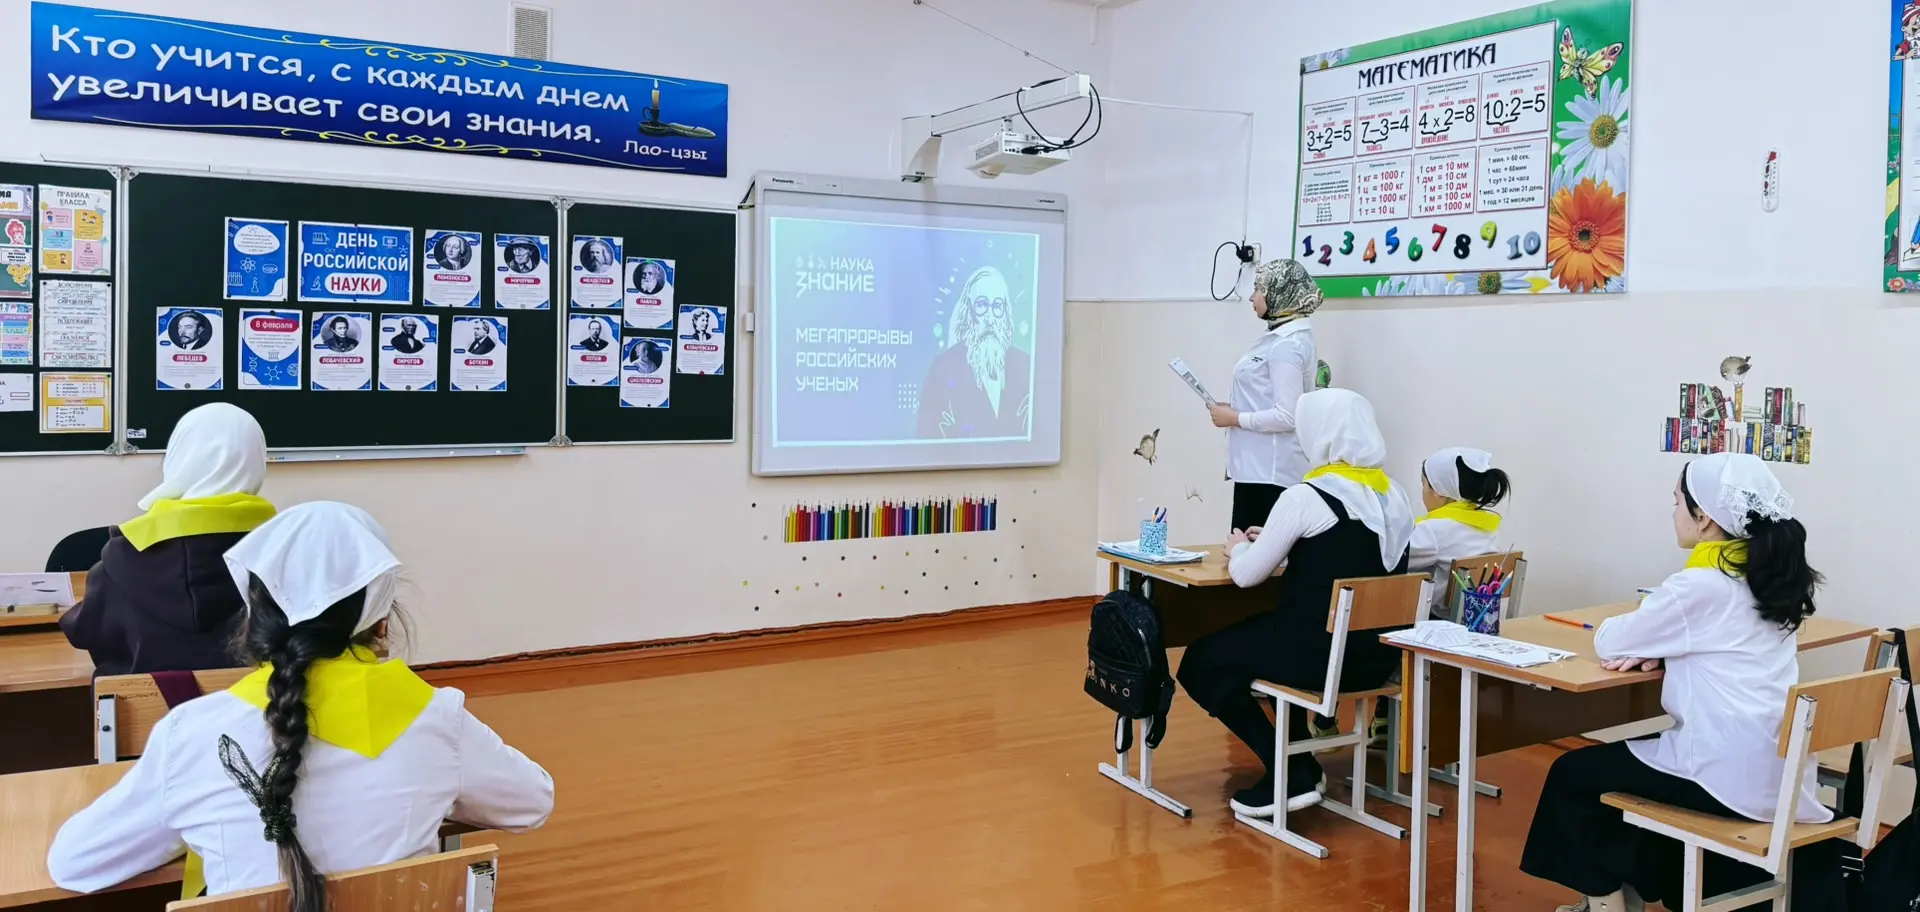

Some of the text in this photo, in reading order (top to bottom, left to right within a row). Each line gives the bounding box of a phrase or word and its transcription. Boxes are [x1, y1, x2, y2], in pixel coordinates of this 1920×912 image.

[51, 24, 629, 113] Кто учится, с каждым днем
[1358, 43, 1497, 88] МАТЕМАТИКА
[48, 70, 601, 143] увеличивает свои знания.
[1483, 93, 1546, 120] 10:2=5
[1307, 125, 1352, 147] 3+2=5
[623, 140, 708, 161] Лао-цзы
[1446, 163, 1454, 171] 10
[1363, 174, 1371, 182] кг
[1380, 170, 1399, 180] 1000
[1422, 176, 1433, 184] дм
[1445, 172, 1454, 181] 10
[1380, 182, 1393, 192] 100
[1445, 182, 1454, 191] 10
[1456, 182, 1468, 191] дм
[57, 191, 90, 199] ПРАВИЛА
[1379, 194, 1397, 203] 1000
[1445, 192, 1458, 201] 100
[1461, 191, 1472, 199] см
[1378, 206, 1387, 214] 10
[1425, 205, 1435, 213] км
[1444, 201, 1462, 211] 1000
[335, 232, 378, 249] ДЕНЬ
[1302, 220, 1541, 266] 1 2 3 4 5 6 7 8 9 10
[303, 252, 408, 272] РОССИЙСКОЙ
[830, 257, 874, 272] НАУКА
[331, 277, 381, 292] НАУКИ
[255, 320, 293, 329] 8 февраля
[796, 327, 913, 345] МЕГАПРОРЫВЫ
[796, 346, 897, 368] РОССИЙСКИХ
[796, 376, 859, 392] УЧЕНЫХ
